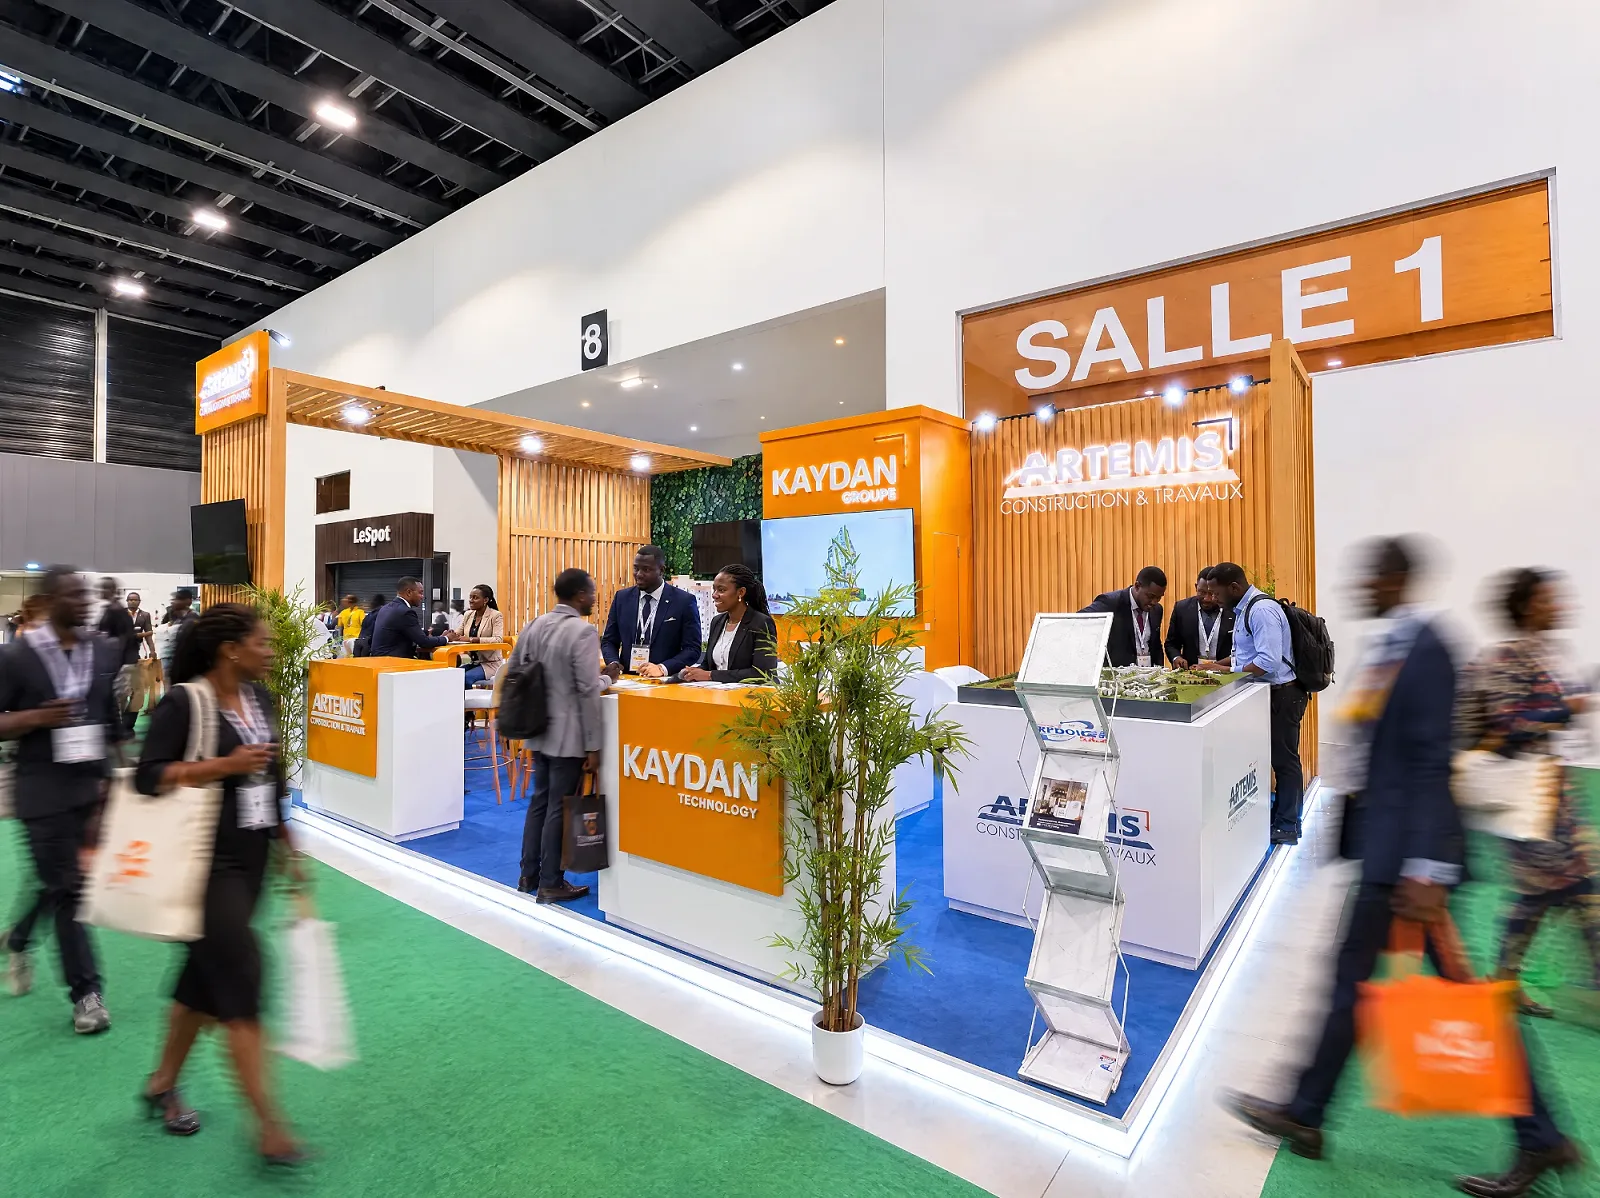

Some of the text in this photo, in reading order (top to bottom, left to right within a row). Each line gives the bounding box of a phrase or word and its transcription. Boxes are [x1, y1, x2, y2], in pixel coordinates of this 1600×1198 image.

[1014, 235, 1444, 390] SALLE 1
[583, 323, 602, 360] 8
[771, 454, 898, 497] KAYDAN
[1015, 431, 1224, 485] ARTEMIS
[841, 486, 898, 505] GROUPE
[1000, 482, 1244, 515] CONSTRUCTION & TRAVAUX
[353, 524, 392, 547] LeSpot
[312, 692, 362, 719] ARTEMIS
[623, 743, 760, 802] KAYDAN
[1228, 768, 1257, 809] ARTEMIS
[677, 792, 758, 819] TECHNOLOGY
